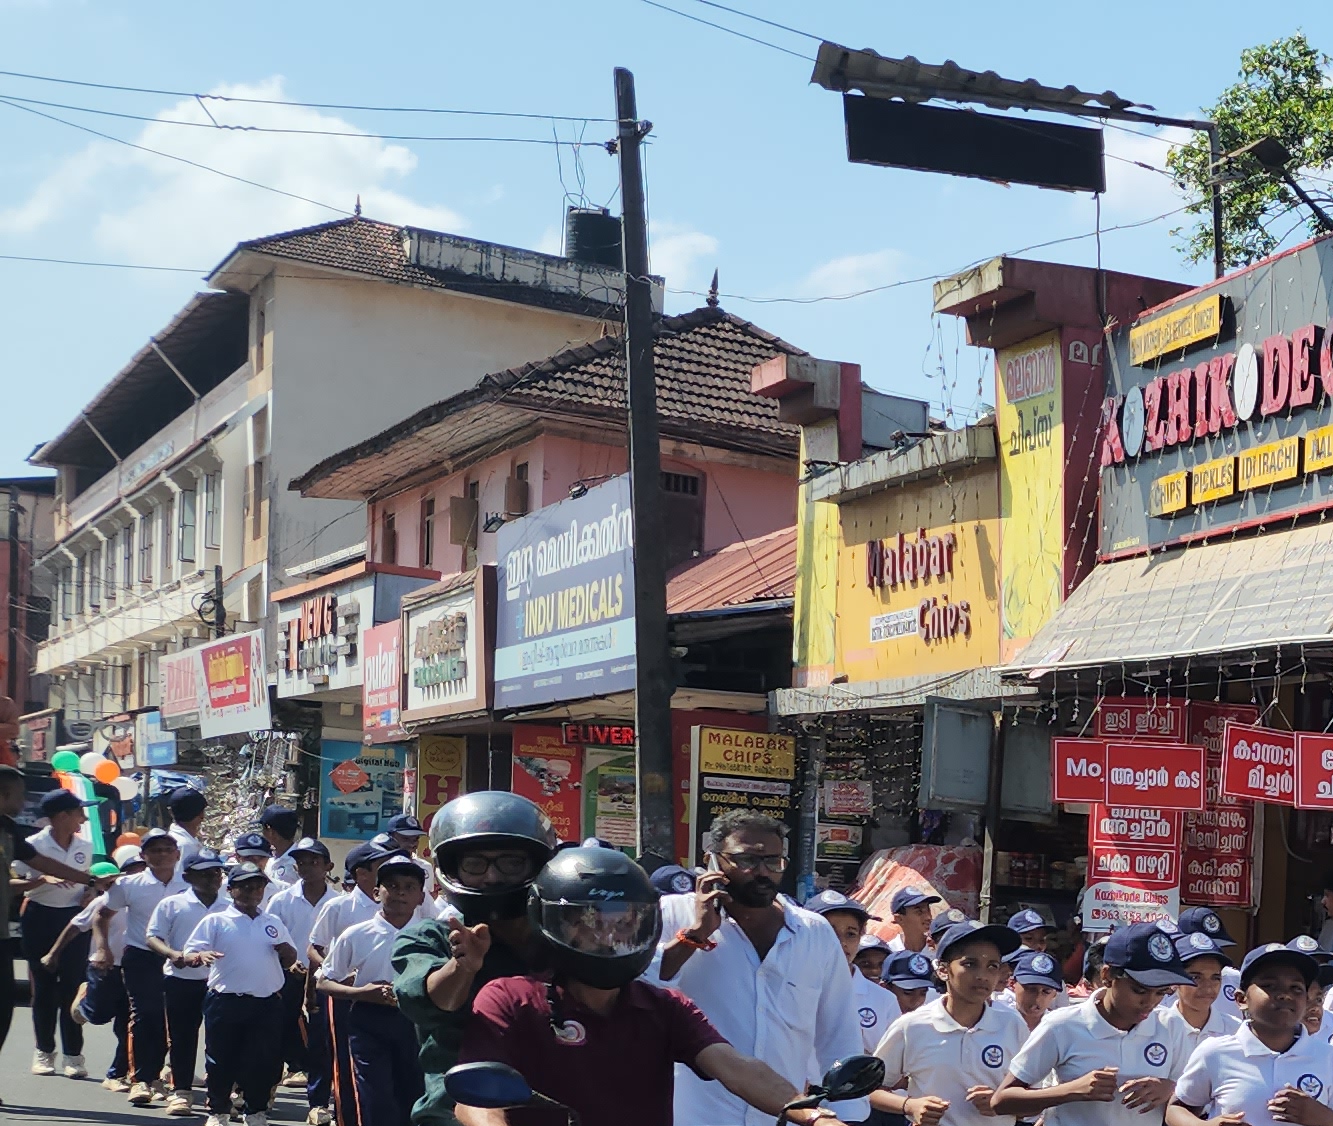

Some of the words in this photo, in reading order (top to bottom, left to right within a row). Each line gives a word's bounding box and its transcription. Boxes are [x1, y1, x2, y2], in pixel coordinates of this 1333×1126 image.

[1192, 463, 1234, 495] PICKLES
[866, 528, 957, 589] Malabar
[525, 593, 553, 638] INDU
[557, 573, 623, 630] MEDICALS
[918, 595, 971, 644] Chips
[708, 732, 788, 750] MALABAR
[723, 749, 773, 765] CHIPS
[1111, 766, 1168, 790] അച്ചാർ
[1175, 772, 1200, 788] കട
[1101, 819, 1171, 840] അച്ചാർ
[1100, 909, 1119, 921] 963
